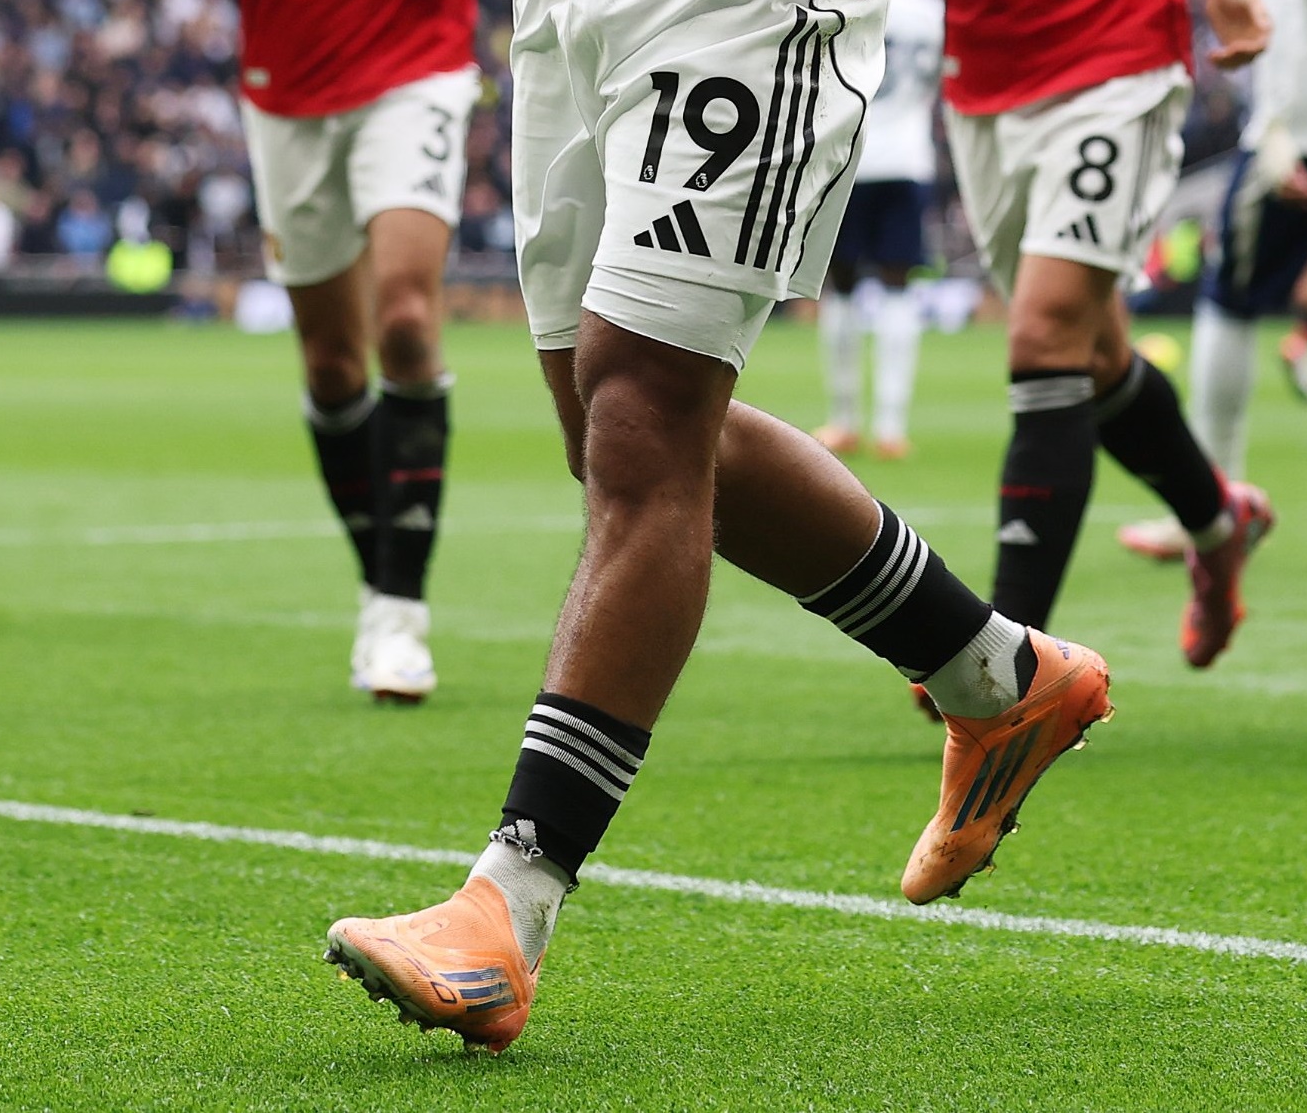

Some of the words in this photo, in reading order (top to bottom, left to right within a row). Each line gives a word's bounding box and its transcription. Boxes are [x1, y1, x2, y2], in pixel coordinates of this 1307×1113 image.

[421, 103, 453, 162] 3
[639, 71, 761, 193] 19
[1069, 135, 1120, 203] 8
